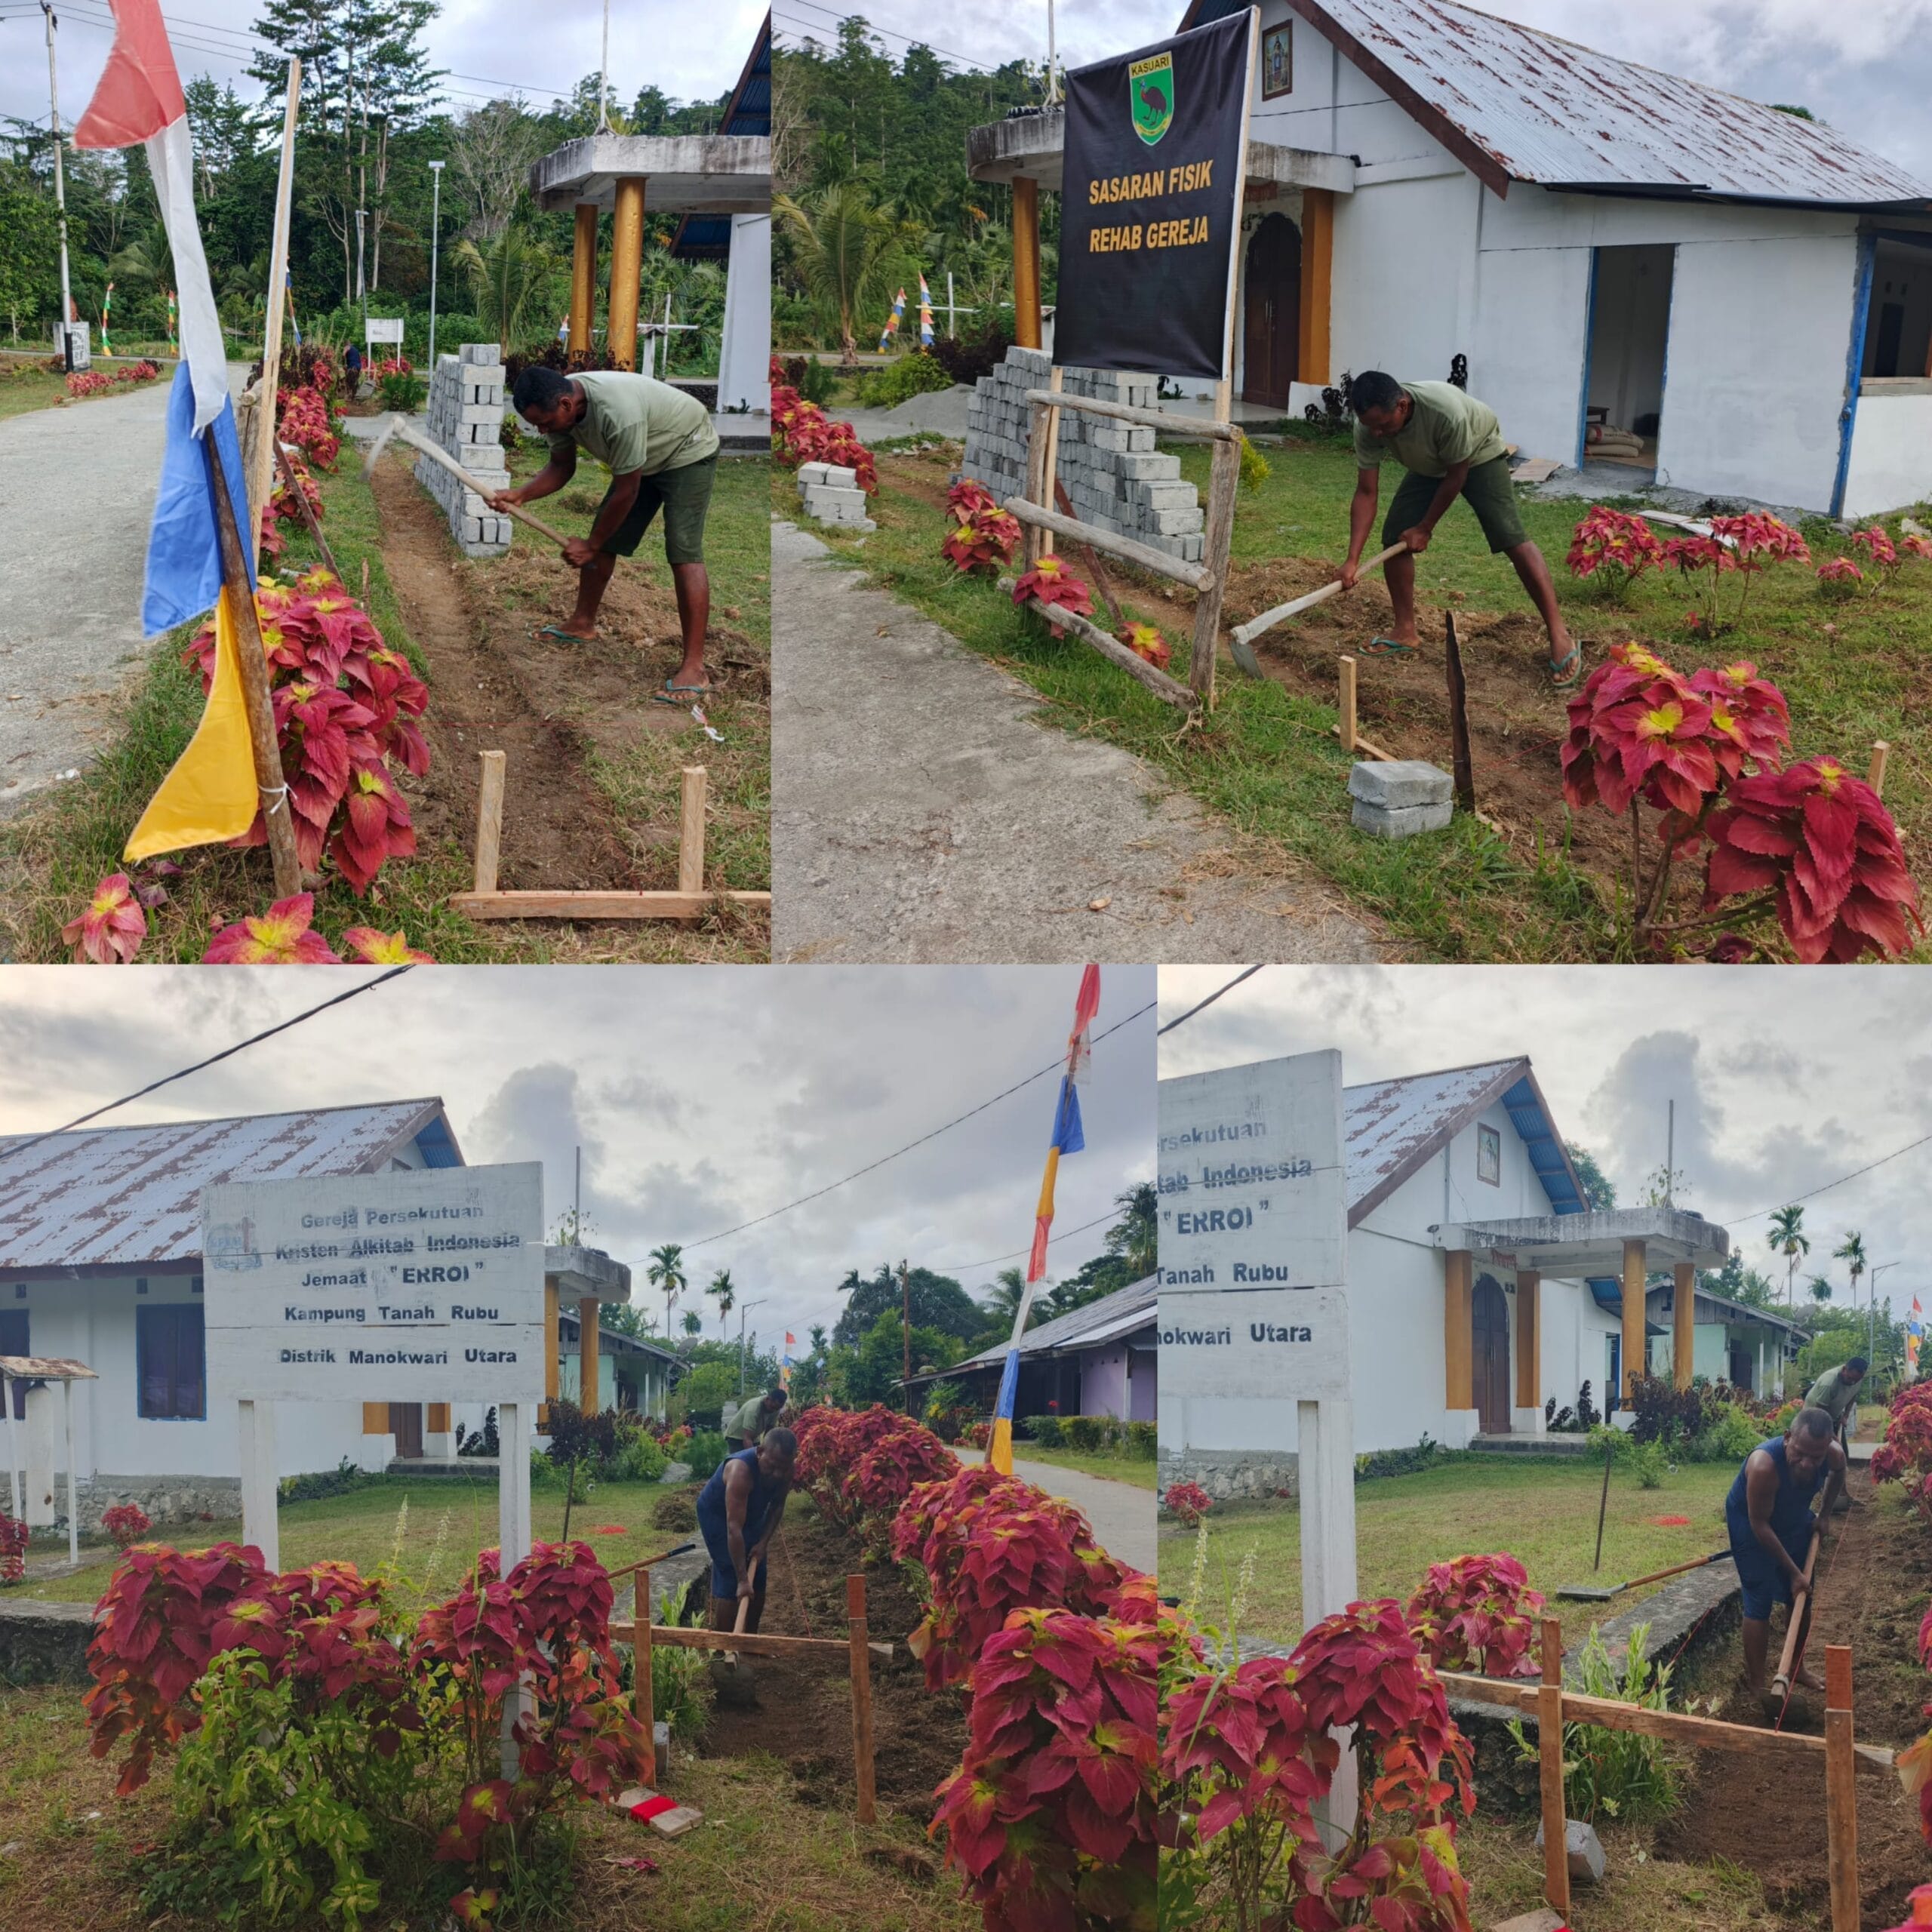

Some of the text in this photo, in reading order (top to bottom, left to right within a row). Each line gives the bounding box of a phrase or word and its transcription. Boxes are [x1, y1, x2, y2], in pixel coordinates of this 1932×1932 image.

[1131, 56, 1170, 75] KASUARI
[1089, 159, 1214, 205] SASARAN FISIK
[1090, 226, 1141, 252] REHAB
[1146, 216, 1208, 248] GEREJA
[1158, 1121, 1266, 1153] rsekutuan
[1203, 1157, 1312, 1189] Indonesia
[301, 1205, 484, 1229] Gereja Persekutuan
[276, 1232, 520, 1260] Kristen Alkitab Indonesia
[301, 1271, 367, 1287] Jemaat
[1233, 1263, 1288, 1282] Rubu
[285, 1306, 498, 1321] Kampung Tanah Rubu
[1251, 1323, 1312, 1343] Utara
[281, 1349, 516, 1364] Distrik Manokwari Utara
